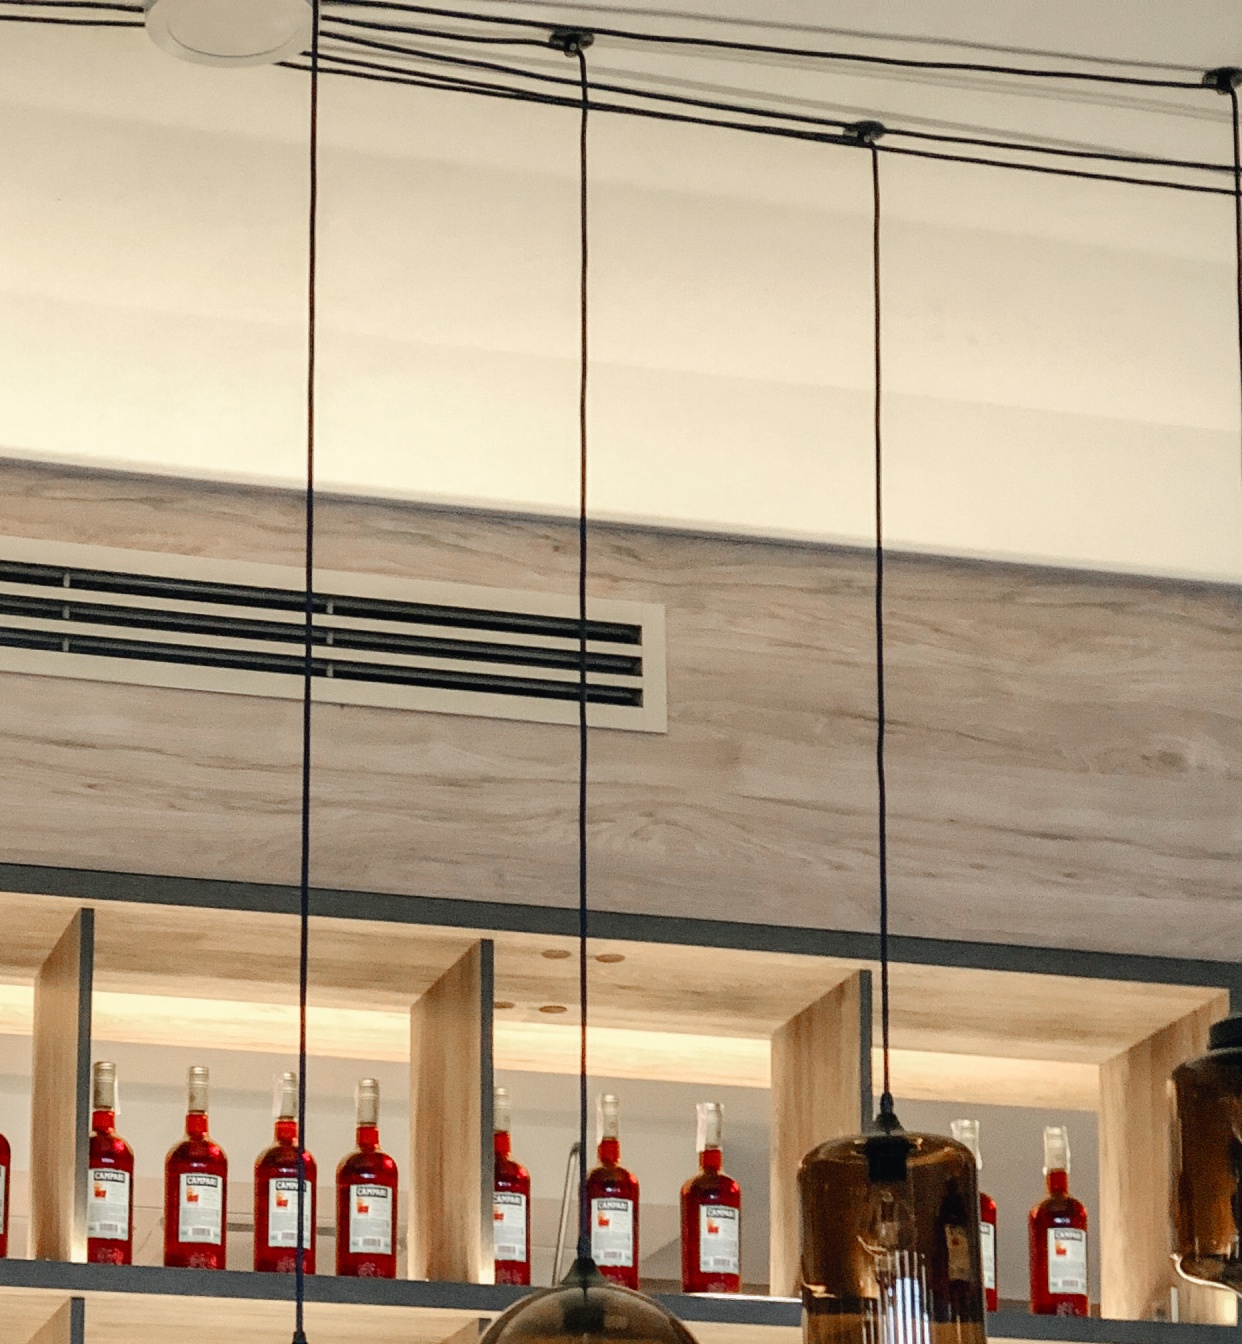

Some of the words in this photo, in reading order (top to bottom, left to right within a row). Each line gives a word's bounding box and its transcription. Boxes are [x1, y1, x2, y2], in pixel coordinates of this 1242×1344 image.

[94, 1171, 125, 1183] CAMPARI
[186, 1175, 217, 1187] CAMPARI
[276, 1181, 306, 1192] CAMPI
[357, 1187, 387, 1198] CAMPARI
[598, 1201, 628, 1212] CAMPARI
